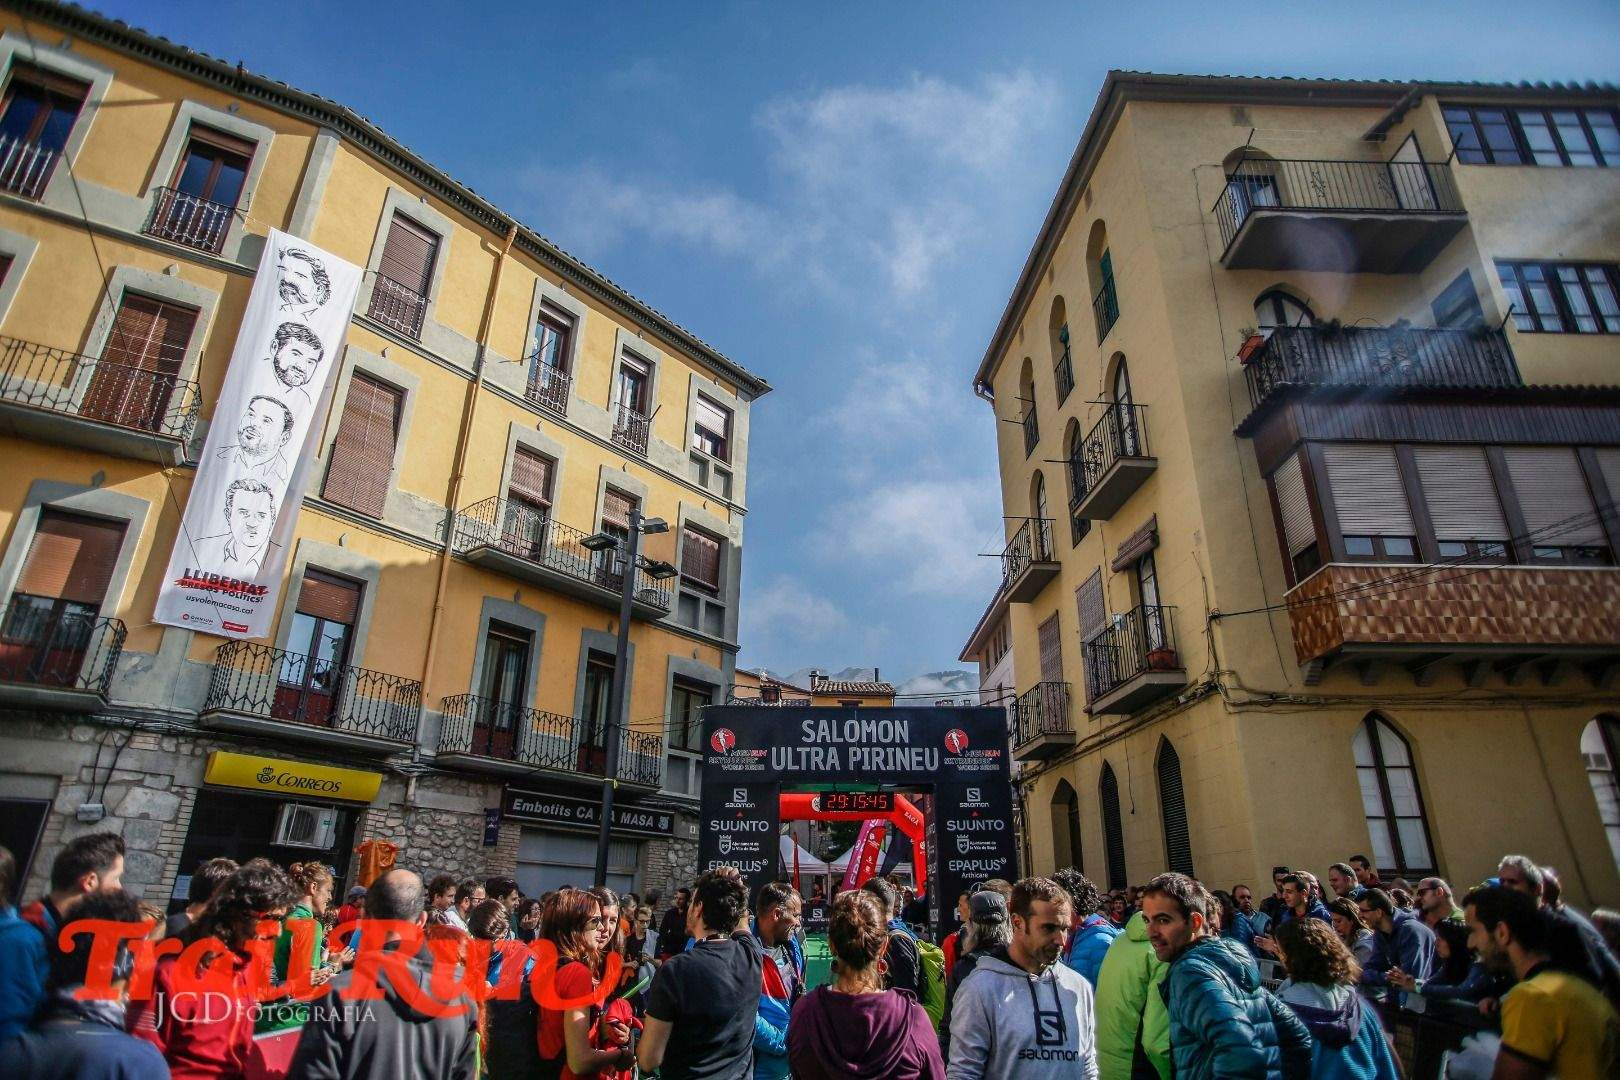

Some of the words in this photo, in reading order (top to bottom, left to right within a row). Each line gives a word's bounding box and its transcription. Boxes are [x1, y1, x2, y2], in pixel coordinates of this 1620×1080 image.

[182, 567, 268, 596] LLIBERTAT
[185, 594, 254, 614] usvolemacasa.cat
[801, 719, 909, 743] SALOMON
[771, 746, 841, 771] ULTRA
[848, 746, 939, 771] PIRINEU
[276, 772, 342, 793] CORREOS
[512, 798, 571, 817] Embotits
[576, 807, 594, 821] CA
[620, 812, 654, 828] MASA
[710, 819, 769, 832] SUUNTO
[946, 819, 1004, 831] SUUNTO
[948, 860, 1001, 871] EPAPLUS
